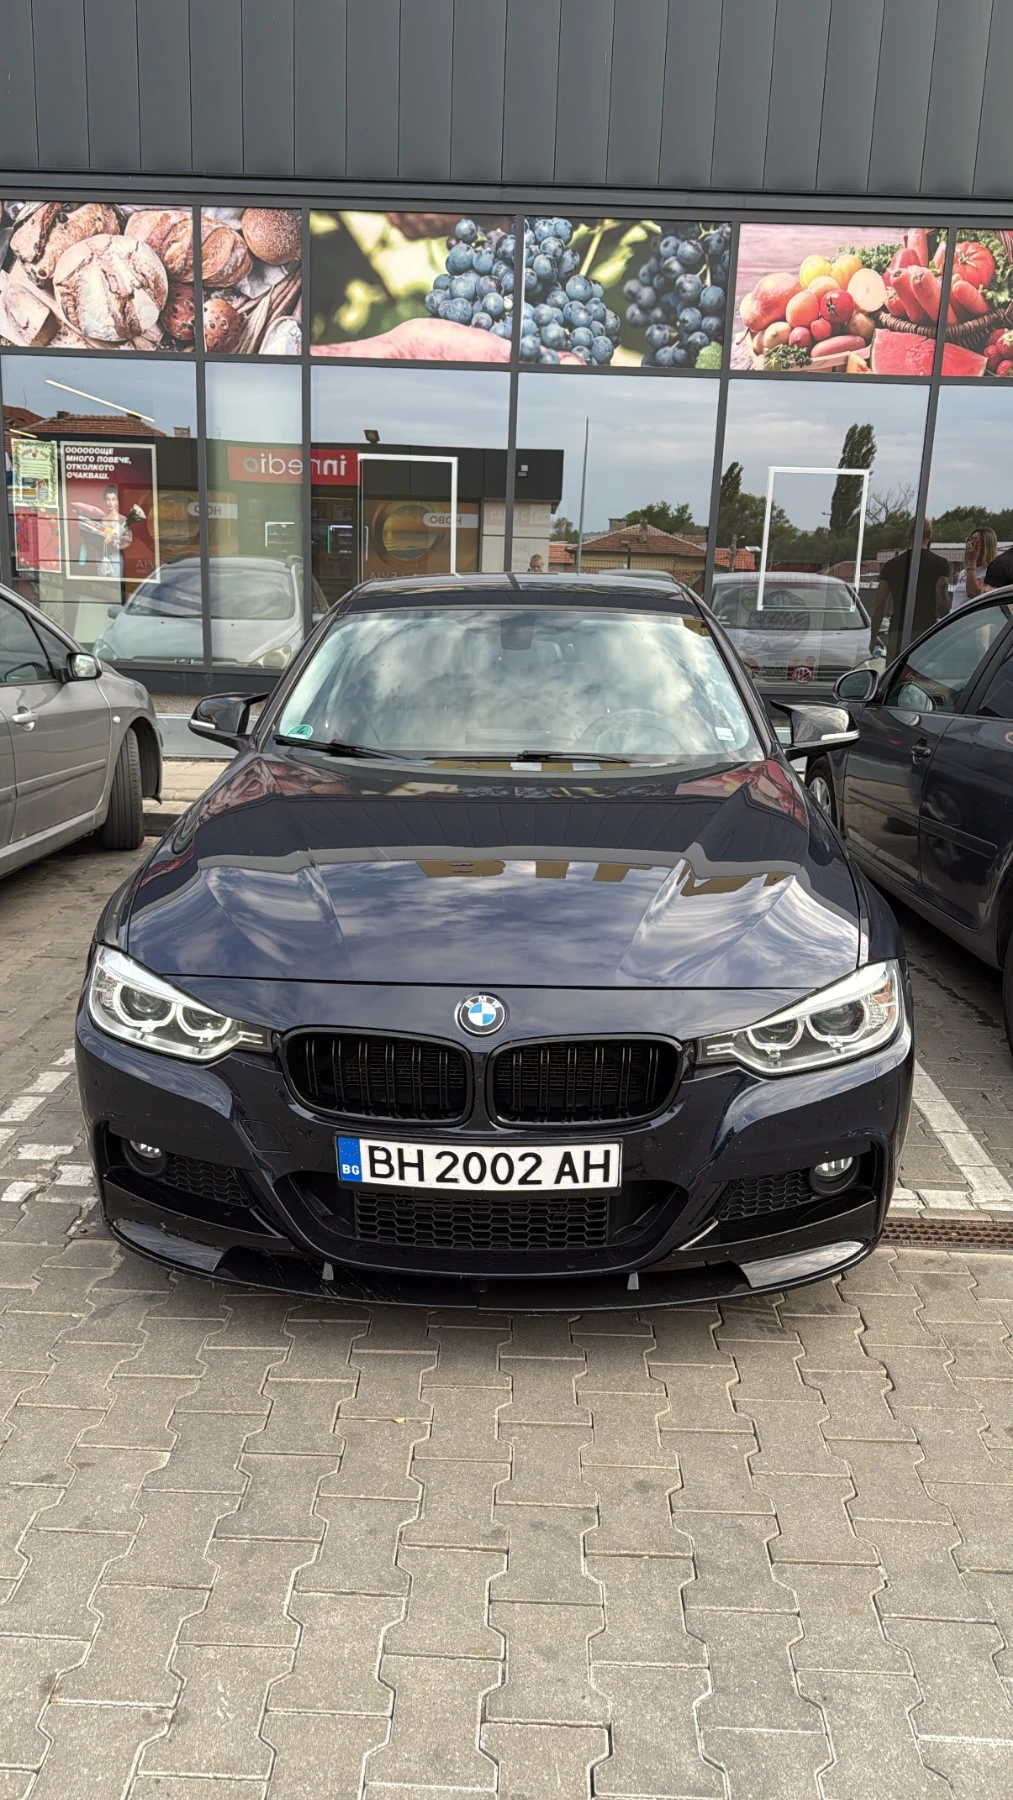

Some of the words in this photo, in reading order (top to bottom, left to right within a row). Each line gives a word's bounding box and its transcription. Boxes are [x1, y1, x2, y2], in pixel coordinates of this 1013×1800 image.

[97, 456, 132, 465] ПОВЕЧЕ,
[66, 463, 115, 471] ОТКОЛКОТО
[66, 471, 109, 479] ОЧАКВАШ.
[464, 996, 502, 1008] BMW
[342, 1164, 360, 1175] BG
[368, 1145, 425, 1182] BH
[435, 1151, 543, 1185] 2002
[553, 1150, 611, 1184] AH
